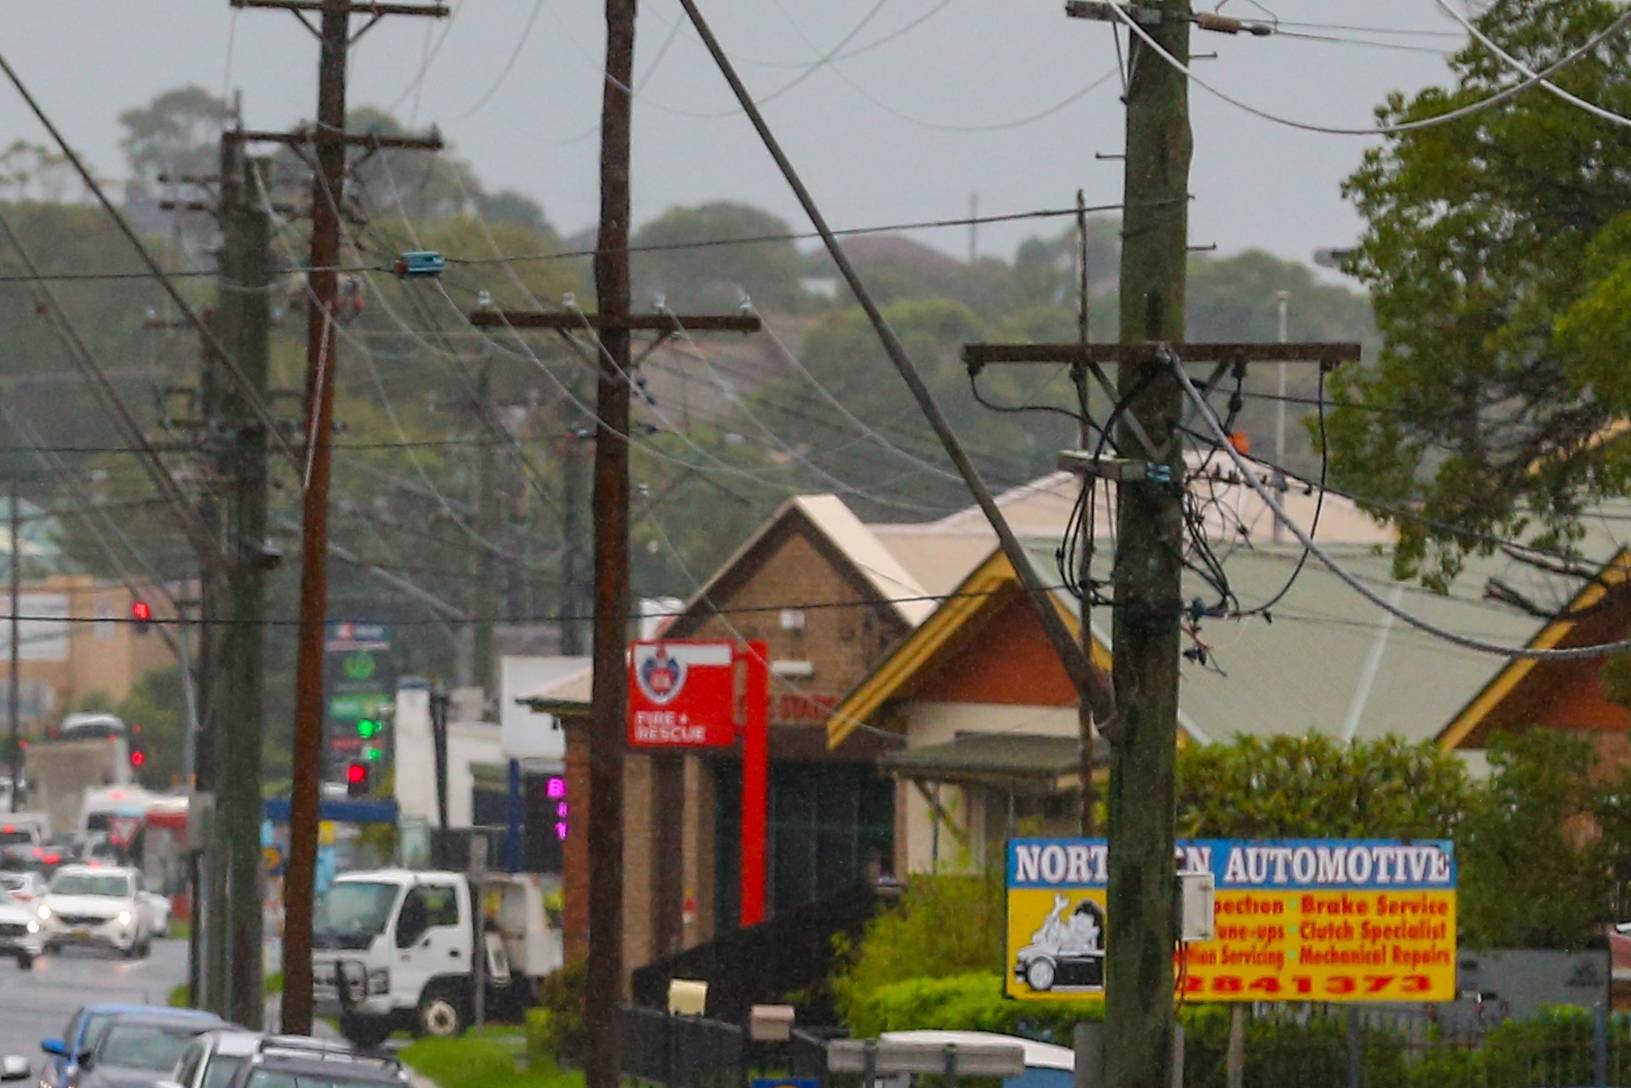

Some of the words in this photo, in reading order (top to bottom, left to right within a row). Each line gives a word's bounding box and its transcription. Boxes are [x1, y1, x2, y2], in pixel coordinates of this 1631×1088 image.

[635, 711, 675, 723] FIRE
[635, 725, 706, 742] RESCUE
[1224, 846, 1450, 884] AUTOMOTIVE
[1301, 892, 1368, 915] Brake
[1375, 893, 1449, 916] Service
[1300, 919, 1355, 940] Clutch
[1361, 920, 1447, 943] Specialist
[1221, 945, 1285, 970] Servicing
[1300, 942, 1387, 965] Mechanical
[1392, 943, 1451, 970] Repairs
